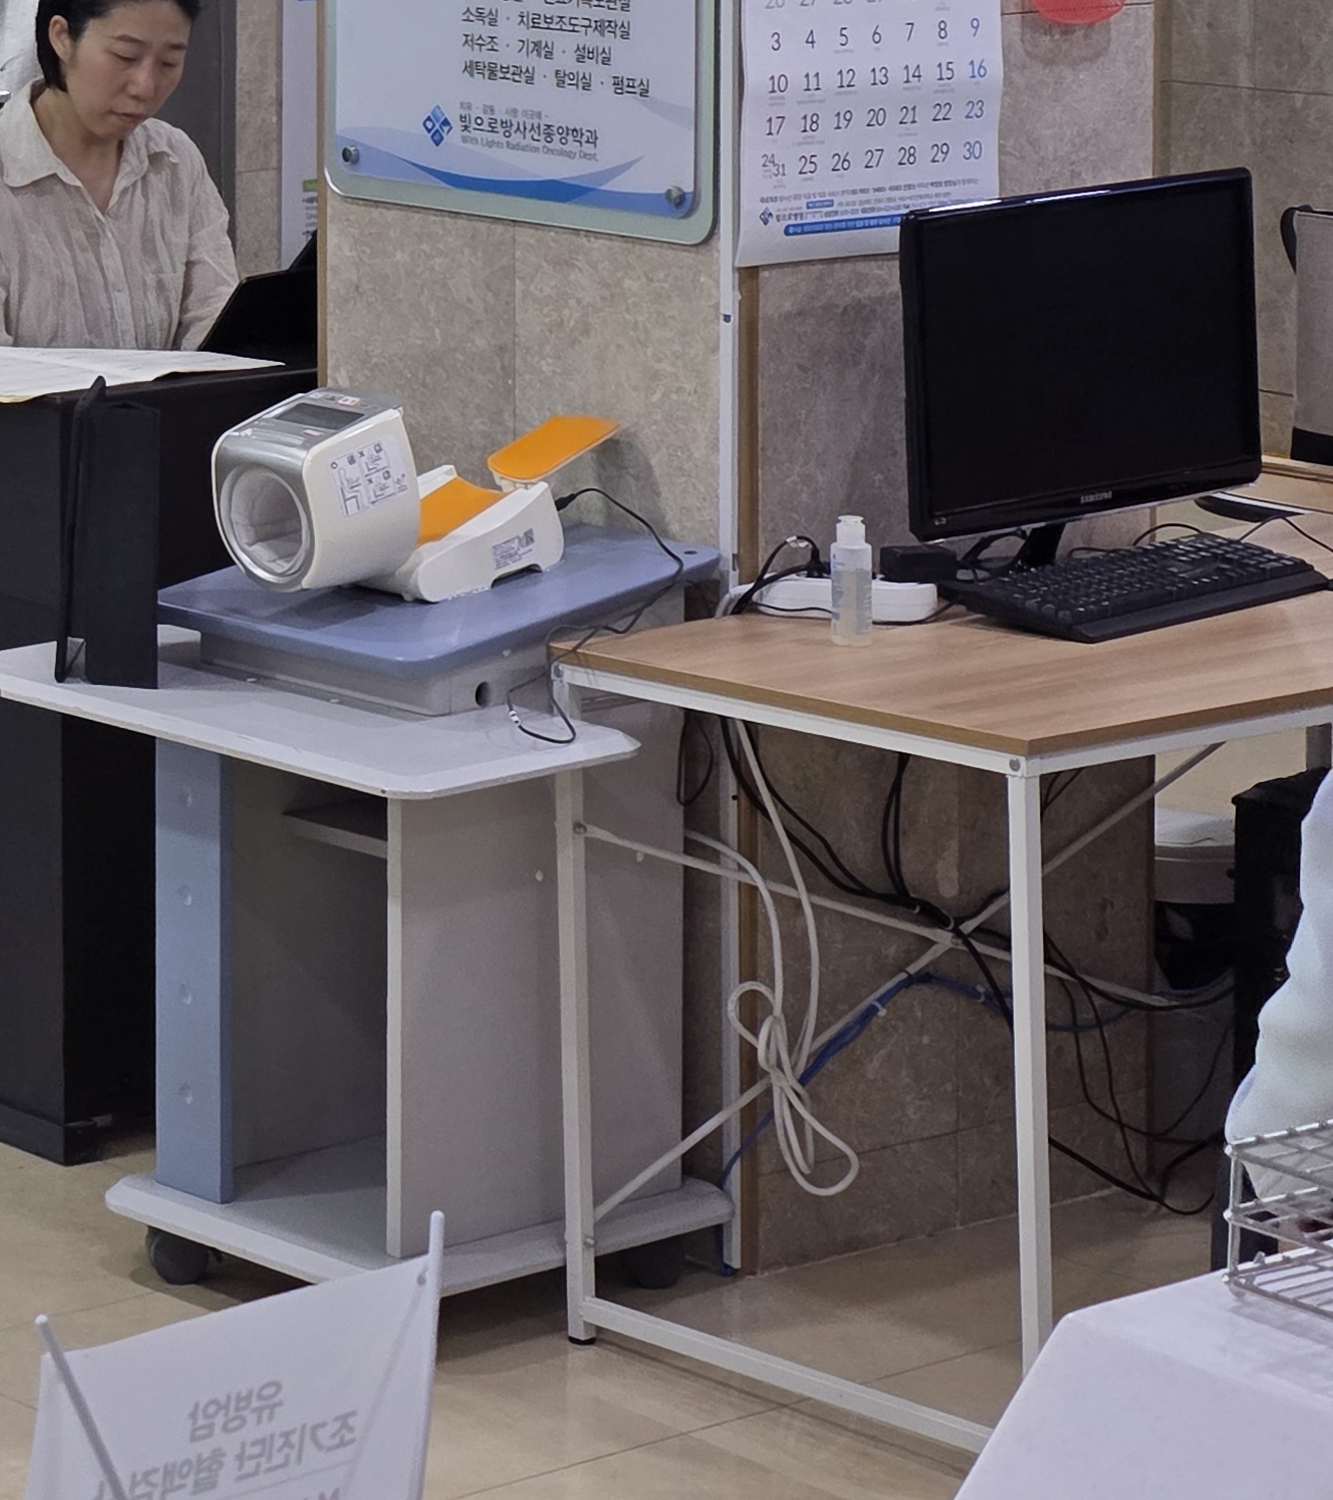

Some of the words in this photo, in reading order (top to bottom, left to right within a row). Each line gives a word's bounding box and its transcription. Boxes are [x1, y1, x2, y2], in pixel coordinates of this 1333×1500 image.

[462, 7, 499, 26] 소독실
[517, 11, 631, 39] 치료보조도구제작실
[771, 32, 781, 51] 3
[805, 29, 816, 49] 4
[838, 27, 849, 46] 5
[872, 24, 882, 44] 6
[905, 22, 915, 42] 7
[937, 20, 948, 39] 8
[970, 17, 980, 37] 9
[462, 34, 499, 54] 저수조
[517, 38, 554, 60] 기계실
[574, 43, 612, 66] 설비실
[462, 60, 535, 85] 세탁물보관실
[554, 69, 592, 91] 탈의실
[612, 75, 650, 97] 펌프실
[768, 73, 788, 94] 10
[802, 71, 822, 91] 11
[836, 68, 856, 89] 12
[870, 66, 889, 86] 13
[902, 63, 922, 84] 14
[936, 61, 955, 82] 15
[968, 59, 987, 79] 16
[459, 113, 598, 148] 빛으로방사선종양학과
[798, 154, 817, 176] 25
[831, 151, 851, 172] 26
[864, 149, 885, 169] 27
[897, 145, 917, 166] 28
[930, 143, 950, 164] 29
[962, 140, 983, 161] 30
